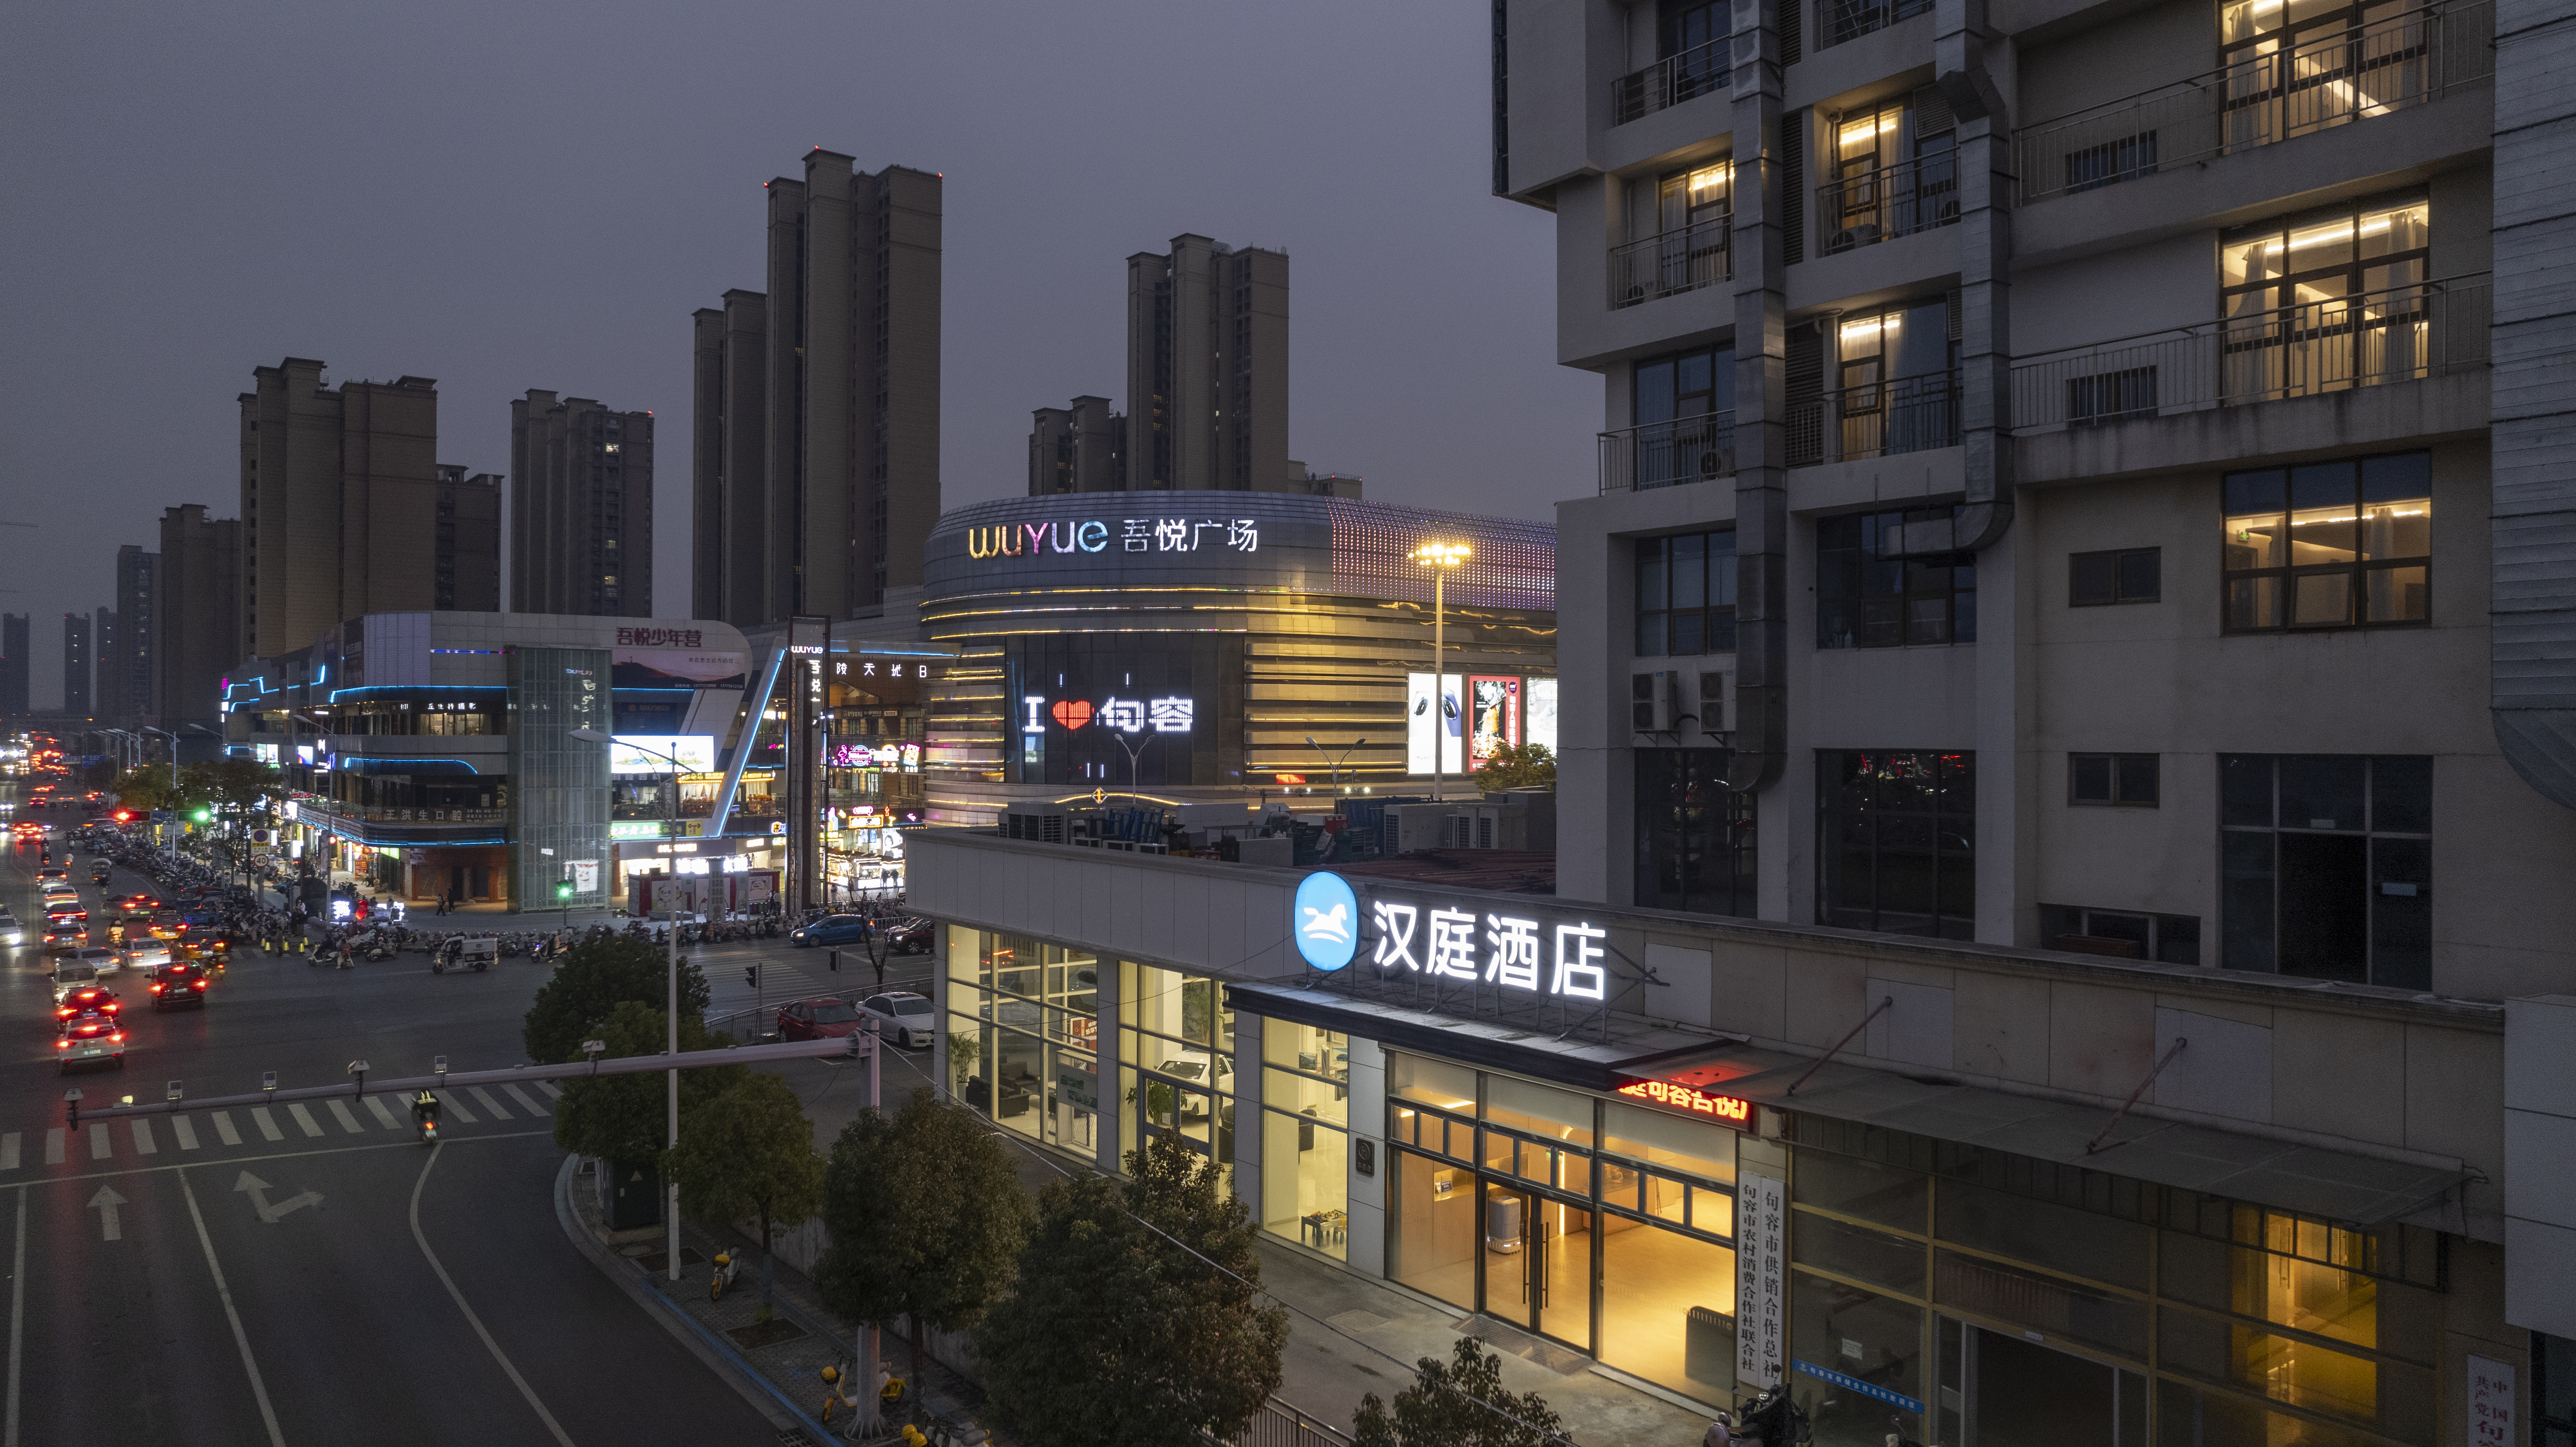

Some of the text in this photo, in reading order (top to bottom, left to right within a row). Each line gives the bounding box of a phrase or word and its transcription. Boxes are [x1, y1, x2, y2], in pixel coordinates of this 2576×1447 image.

[1121, 519, 1258, 552] 吾悦广场
[617, 627, 702, 648] 吾悦少年营
[428, 702, 477, 710] 丘比特摄影
[1099, 696, 1193, 732] 句容
[386, 809, 462, 821] 王洪生口腔
[1374, 900, 1606, 1000] 汉庭酒店
[1741, 1184, 1757, 1373] 句容市农村消费合作社联合社
[1763, 1192, 1780, 1379] 句容市供销合作总社
[1810, 1367, 1915, 1409] 句容市供销合作总社欢迎您
